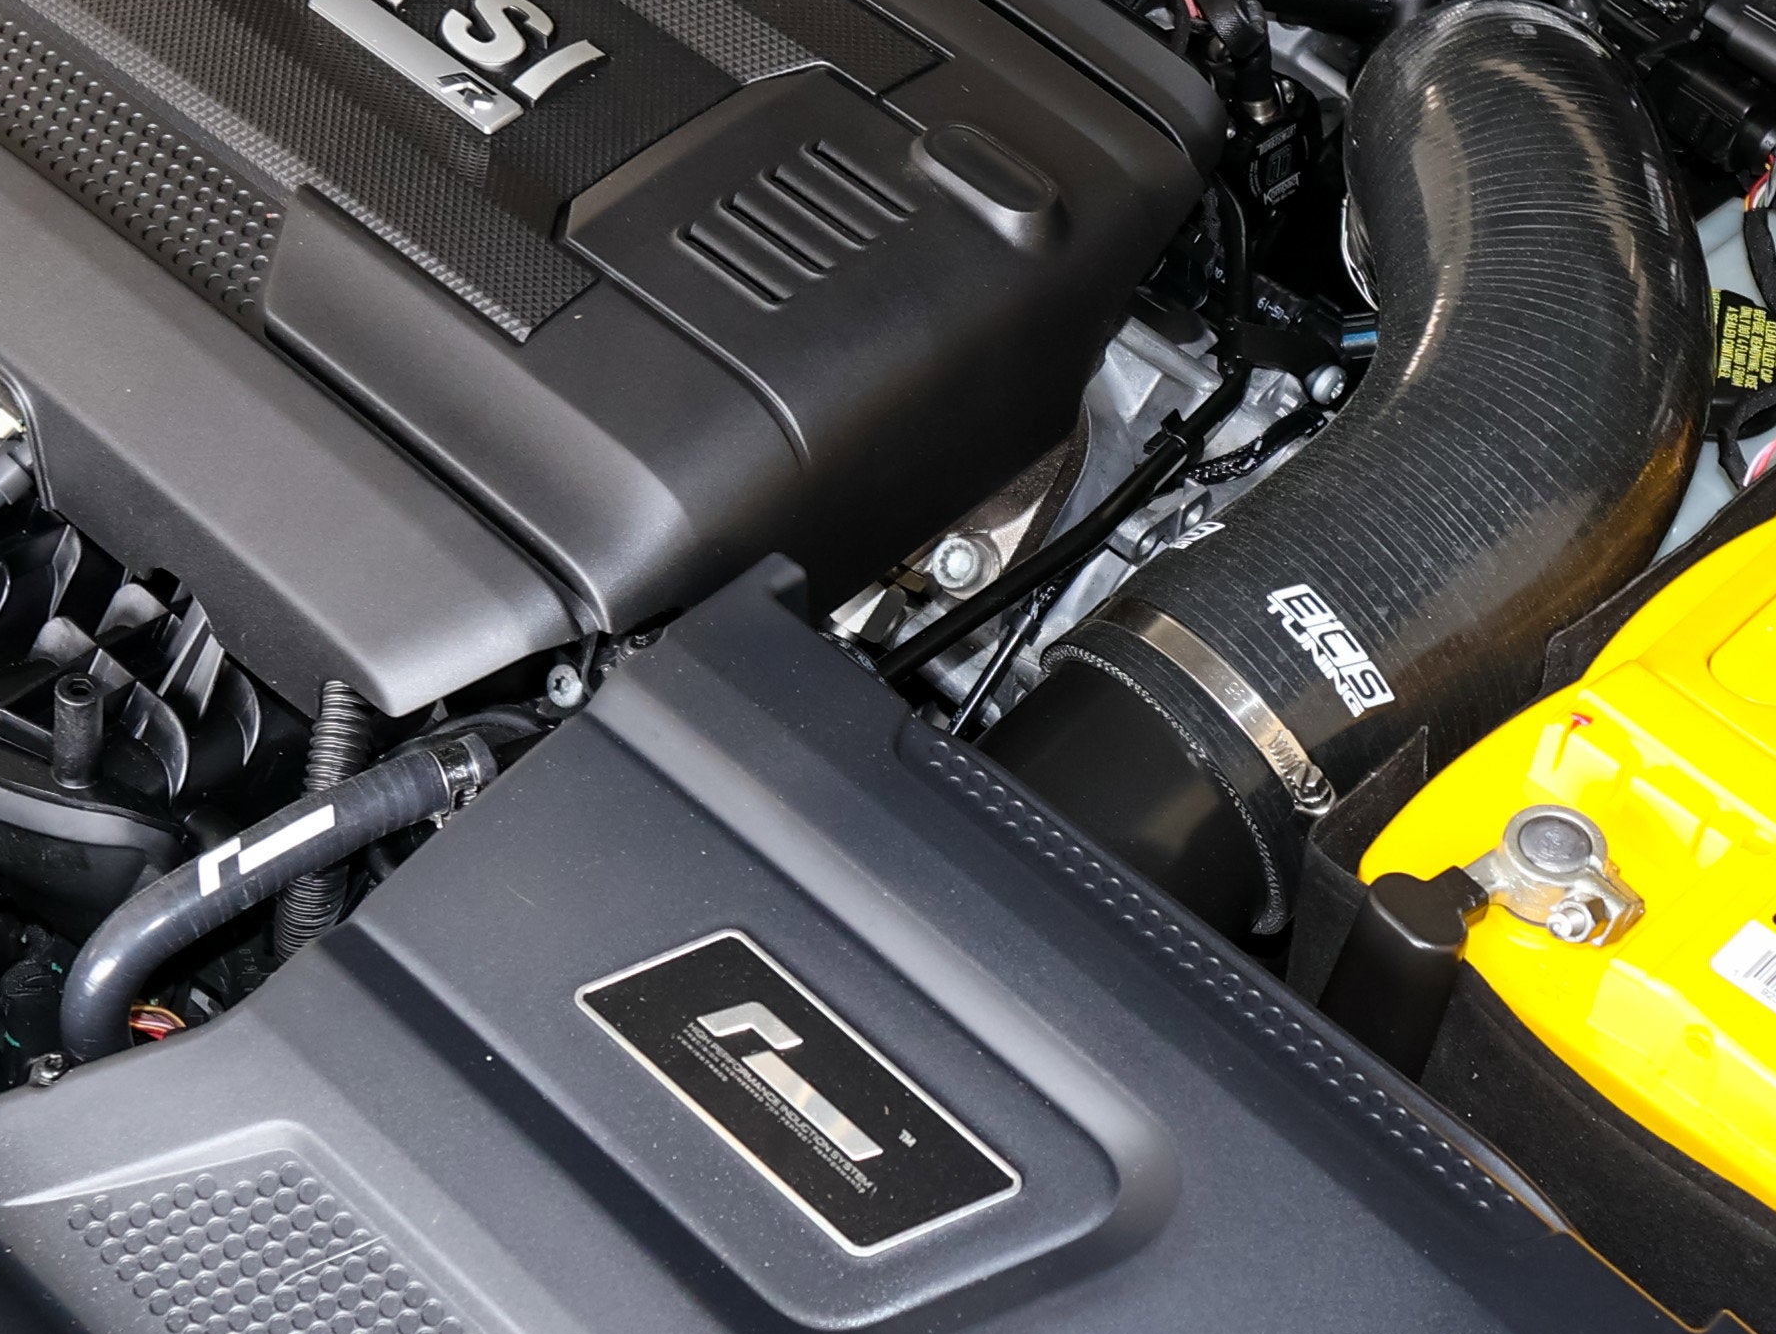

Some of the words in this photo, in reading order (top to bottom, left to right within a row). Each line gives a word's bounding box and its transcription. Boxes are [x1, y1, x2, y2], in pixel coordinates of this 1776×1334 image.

[435, 71, 497, 116] R
[1760, 368, 1773, 383] CAP
[1761, 344, 1775, 367] FILLER
[1266, 593, 1365, 718] TUNING
[1270, 584, 1395, 709] ECS
[686, 1020, 713, 1046] HIGH
[709, 1039, 783, 1109] PERFORMANCE
[778, 1102, 833, 1154] INDUCTION
[829, 1148, 873, 1190] SYSTEM
